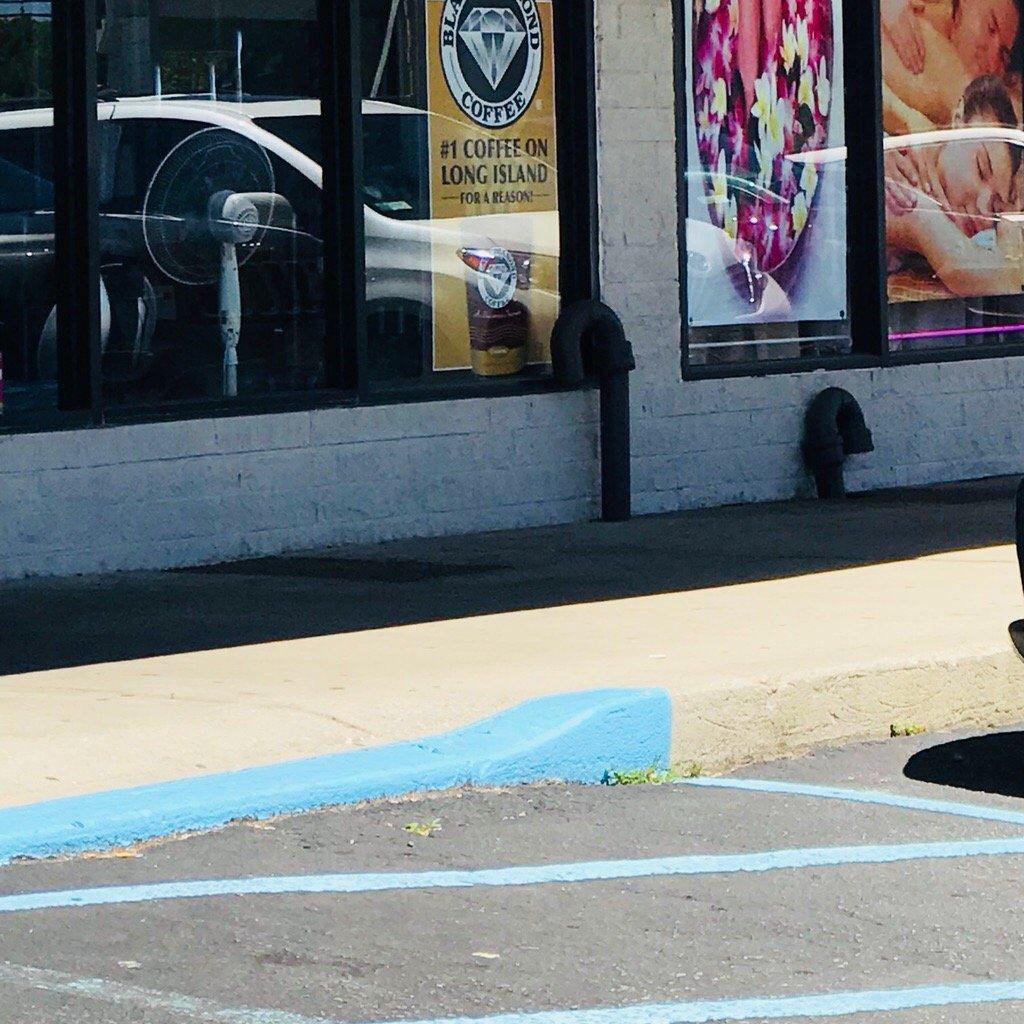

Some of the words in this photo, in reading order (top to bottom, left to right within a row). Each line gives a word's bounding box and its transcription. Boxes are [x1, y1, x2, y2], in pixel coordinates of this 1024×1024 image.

[461, 90, 526, 124] COFFEE
[440, 142, 458, 159] #1
[463, 139, 522, 159] COFFEE
[525, 138, 547, 158] ON
[441, 165, 489, 185] LONG
[493, 163, 548, 184] ISLAND
[460, 193, 480, 205] FOR
[483, 193, 490, 205] A
[492, 191, 534, 204] REASON!
